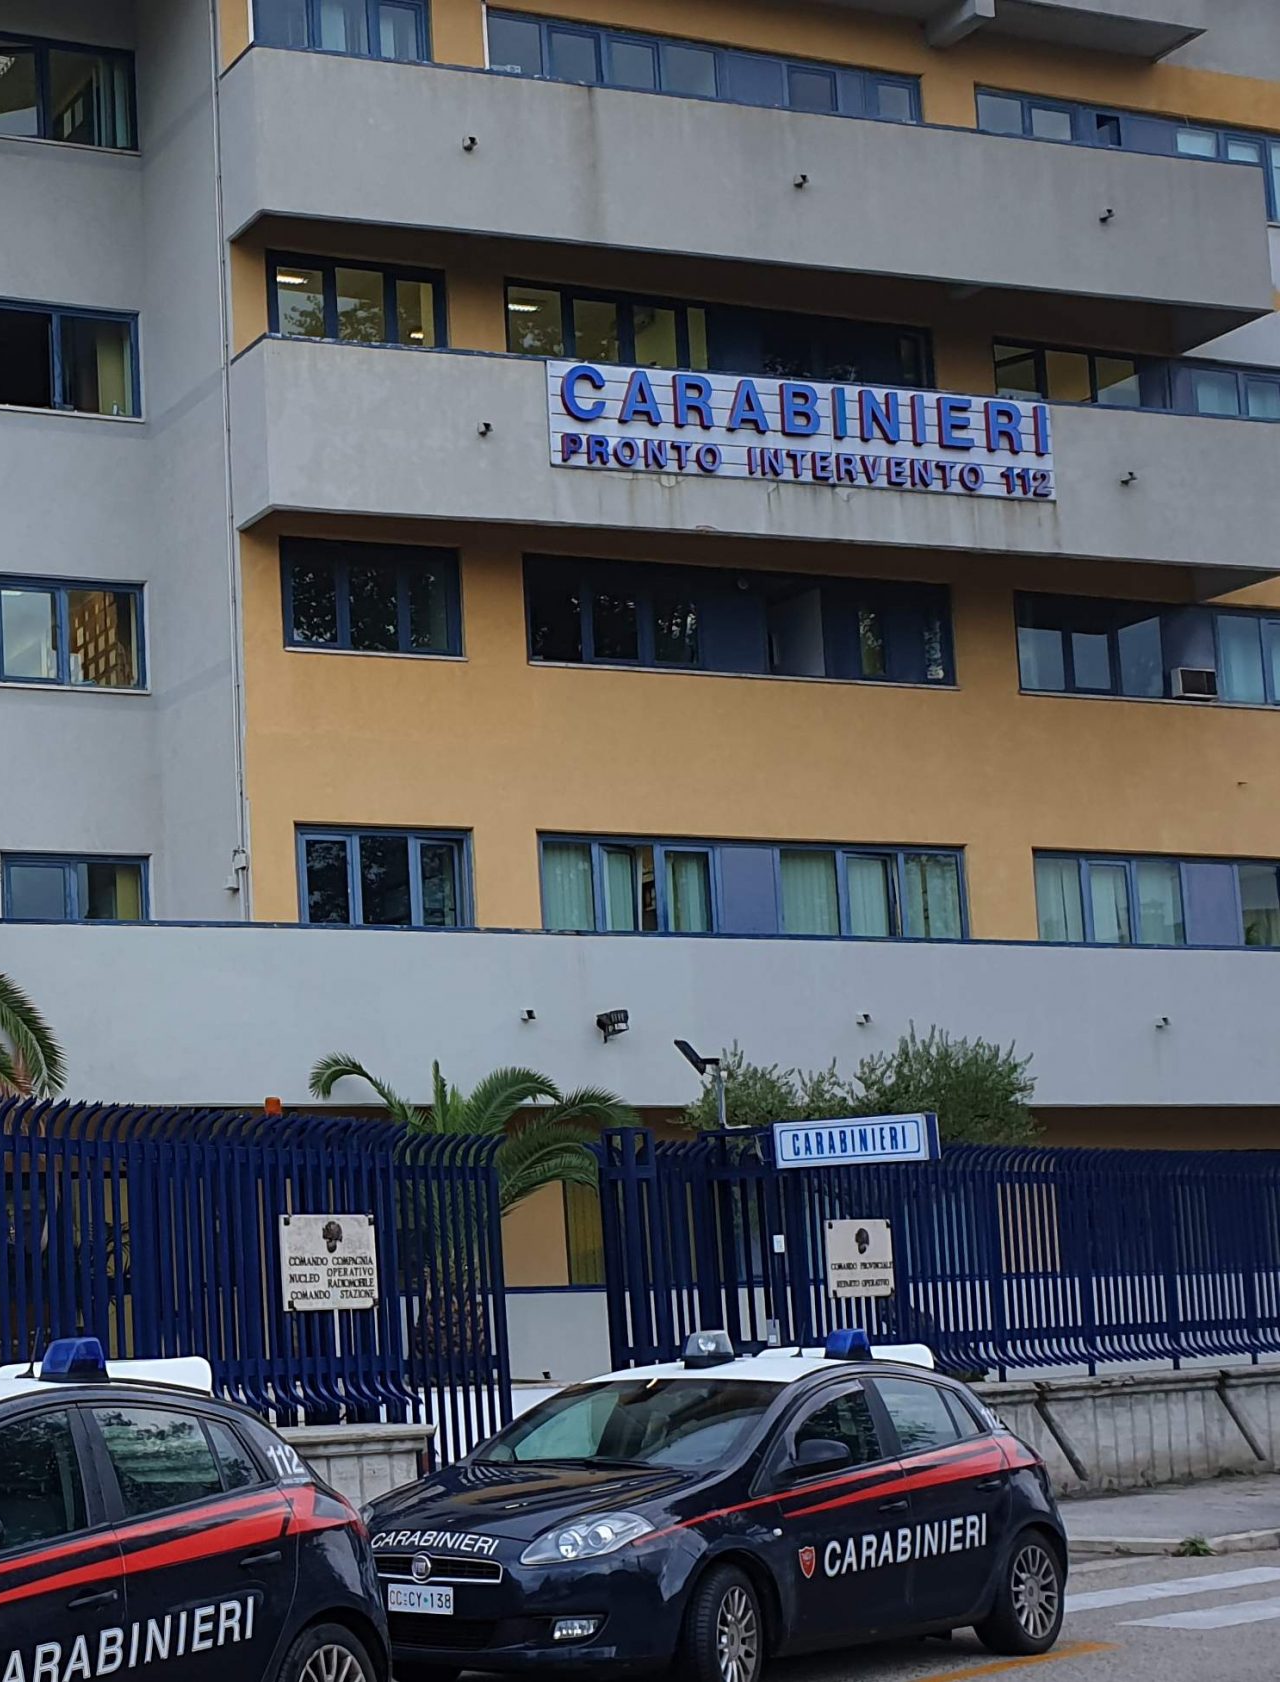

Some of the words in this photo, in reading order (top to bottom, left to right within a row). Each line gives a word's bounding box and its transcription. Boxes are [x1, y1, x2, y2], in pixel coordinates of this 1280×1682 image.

[560, 364, 1049, 457] CARABINIERI
[561, 432, 722, 473] PRONTO
[747, 446, 984, 491] INTERVENTO
[1000, 465, 1053, 497] 112
[792, 1125, 907, 1156] CARABINIERI
[288, 1256, 329, 1267] COMANDO
[332, 1255, 373, 1266] COMPAGNIA
[326, 1267, 374, 1277] OPERATIVO
[289, 1273, 320, 1284] NUCLEO
[327, 1278, 375, 1288] RADIOMOBILE
[290, 1290, 331, 1300] COMANDO
[340, 1289, 375, 1299] STAZIONE
[266, 1444, 305, 1477] 112
[370, 1530, 500, 1556] CARABINIERI
[823, 1512, 988, 1578] CARABINIERI
